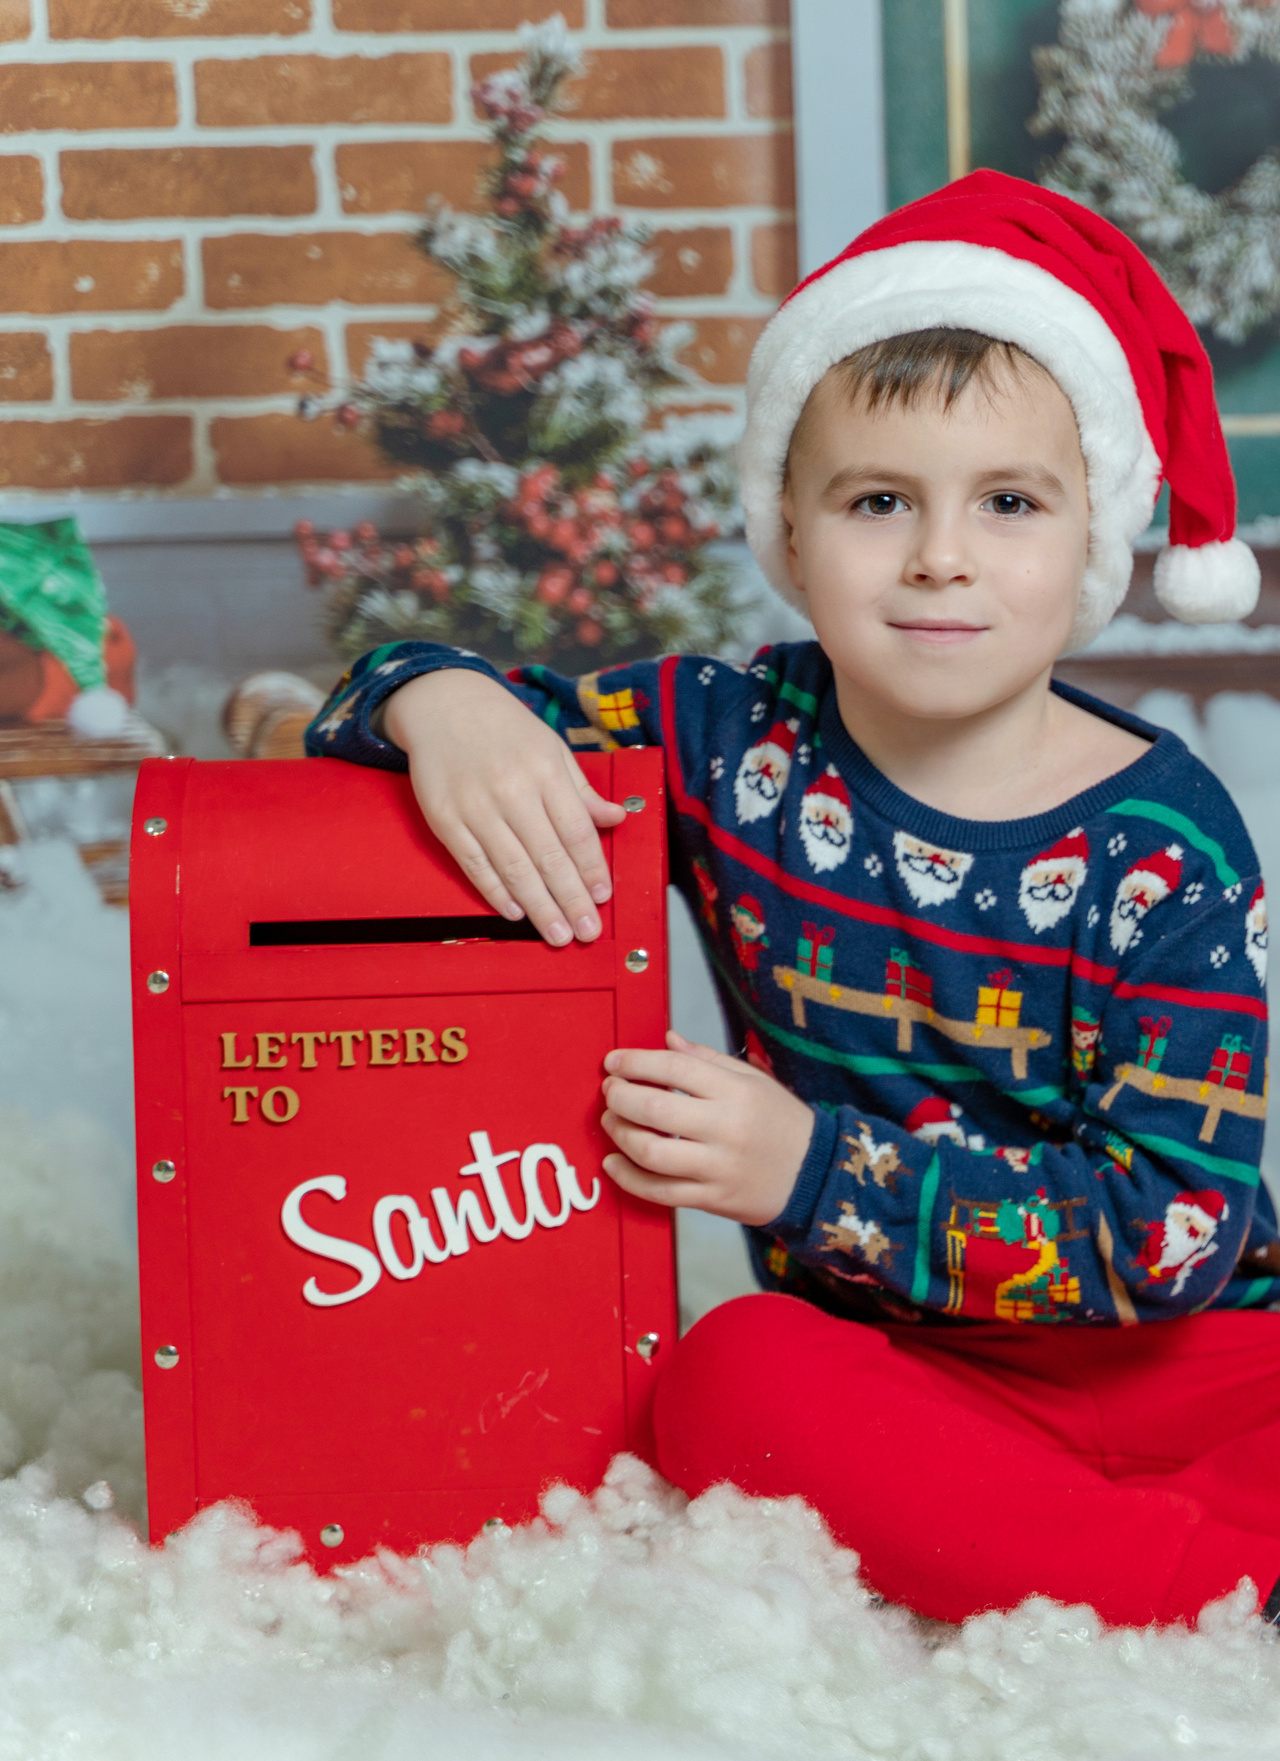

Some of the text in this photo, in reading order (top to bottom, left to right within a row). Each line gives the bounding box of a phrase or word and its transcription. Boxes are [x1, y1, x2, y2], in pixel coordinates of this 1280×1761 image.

[220, 1027, 469, 1069] LETTERS
[224, 1086, 300, 1124] TO
[281, 1130, 600, 1306] Santa
